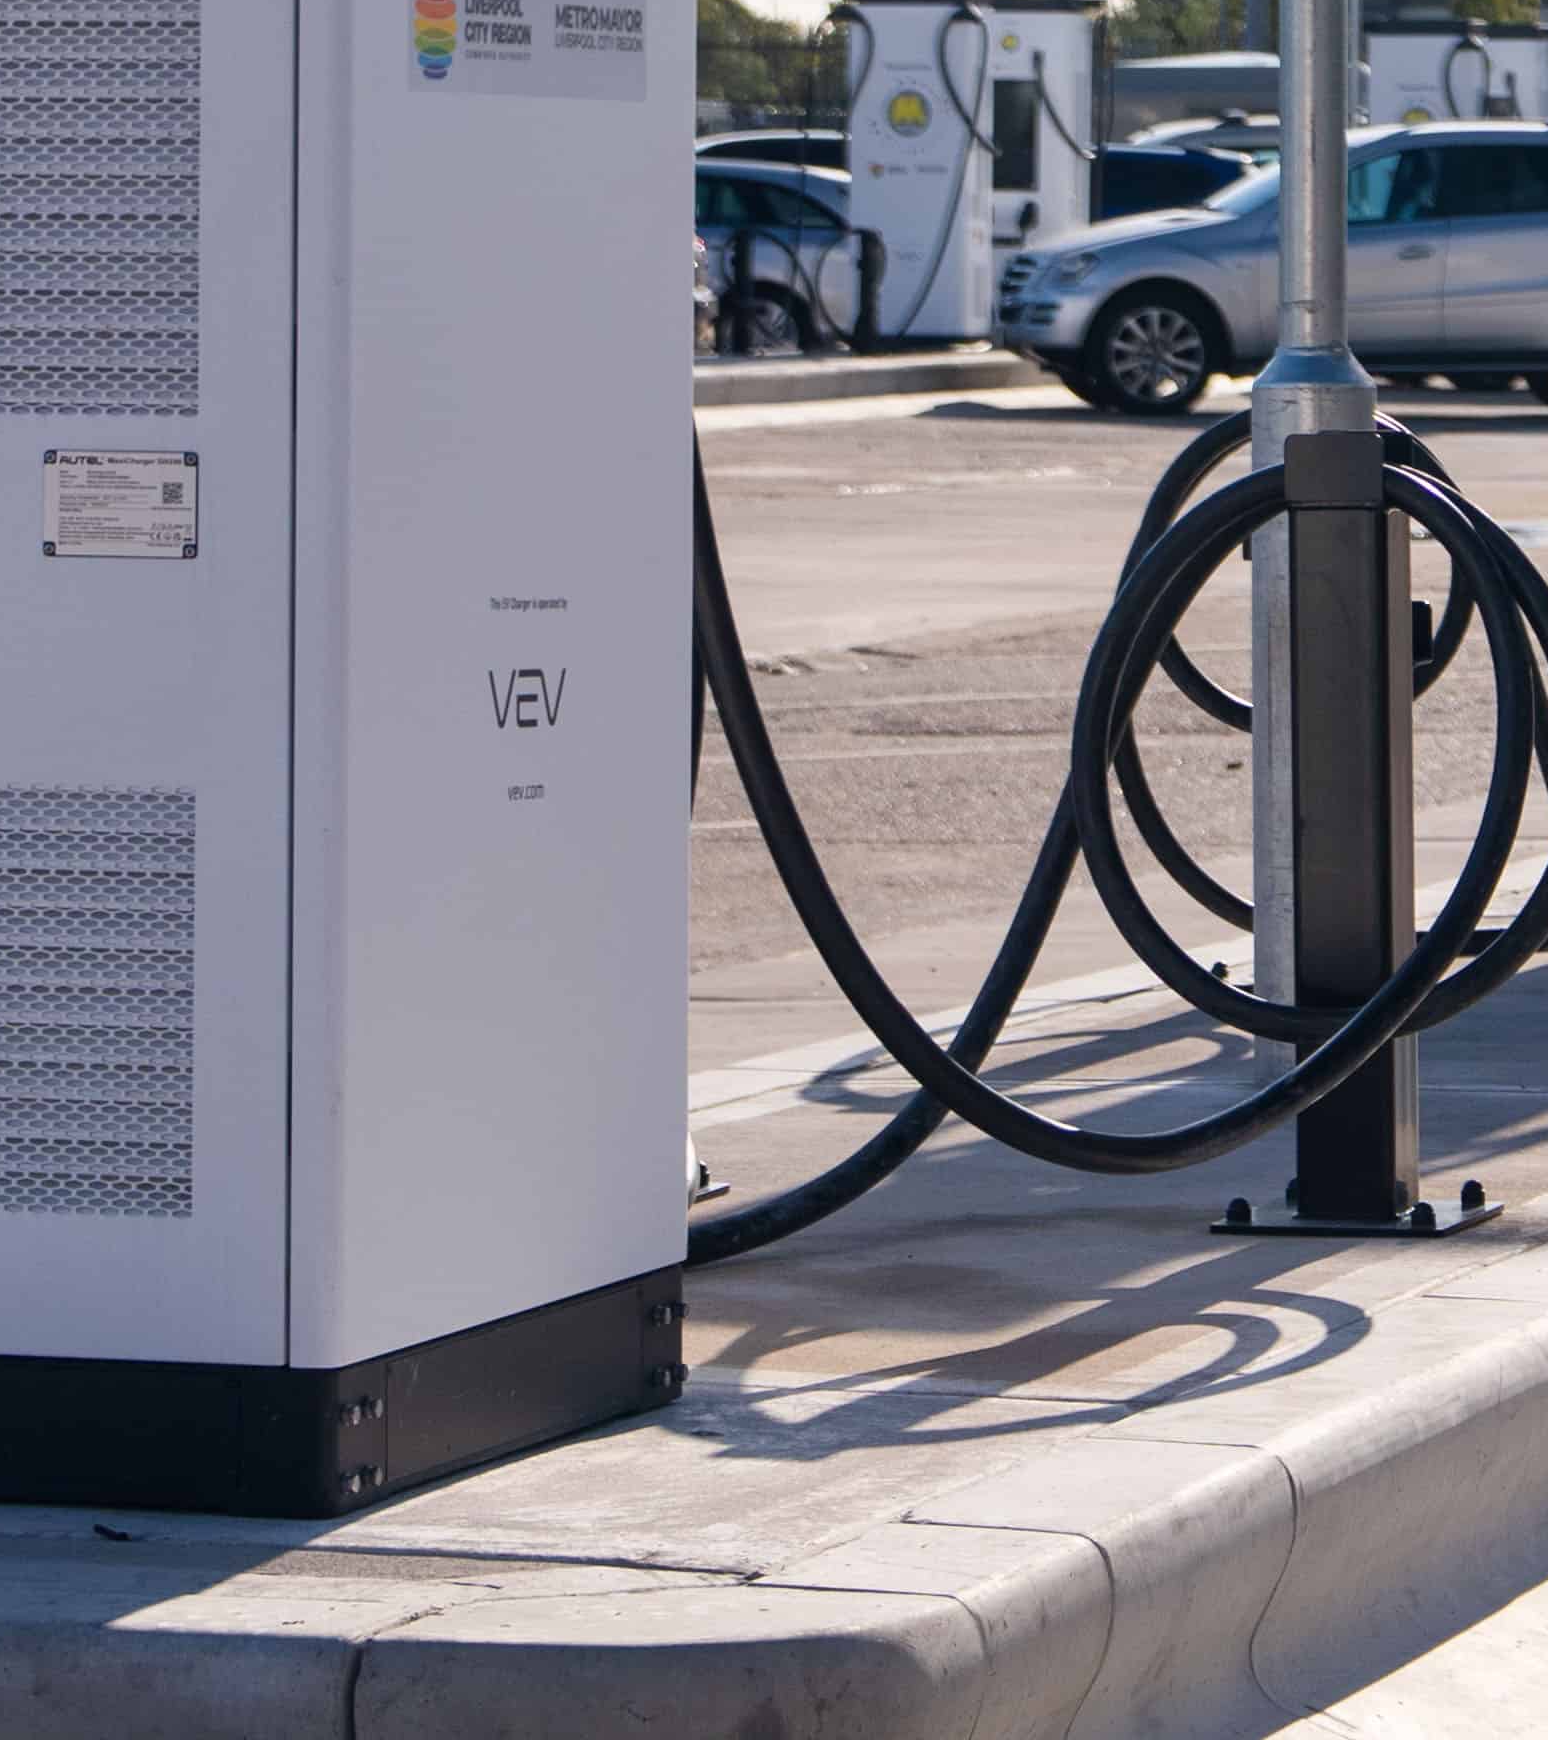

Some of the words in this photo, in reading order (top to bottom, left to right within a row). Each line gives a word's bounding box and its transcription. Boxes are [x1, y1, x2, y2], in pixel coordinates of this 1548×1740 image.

[464, 21, 489, 44] CITY
[491, 22, 532, 46] REGION
[59, 455, 104, 466] AUTEL
[488, 667, 567, 729] VEV
